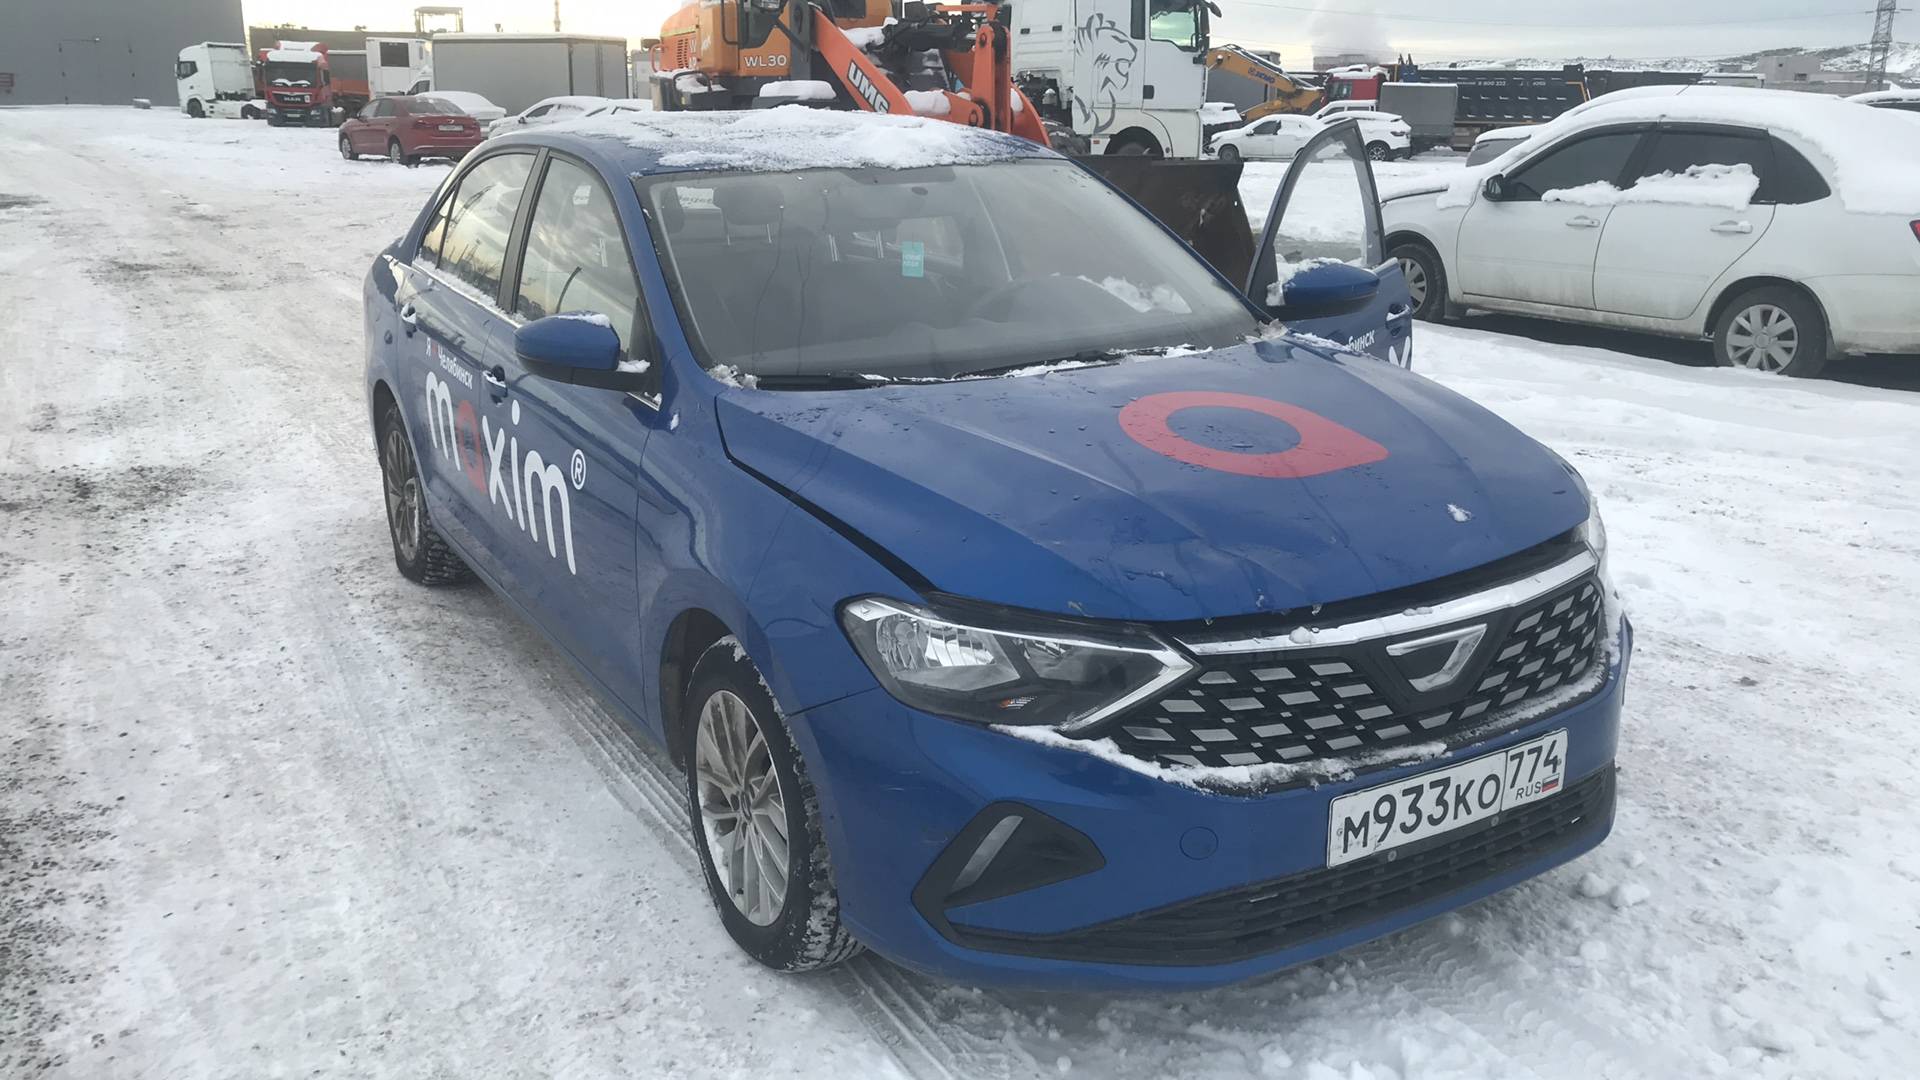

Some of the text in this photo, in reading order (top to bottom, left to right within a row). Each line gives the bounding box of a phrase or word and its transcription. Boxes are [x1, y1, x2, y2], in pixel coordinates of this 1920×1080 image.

[744, 55, 787, 67] WL30
[848, 61, 890, 113] UMG
[425, 336, 473, 390] Я Челябинск
[1342, 739, 1560, 854] М933КО 774
[1515, 783, 1542, 801] RUS
